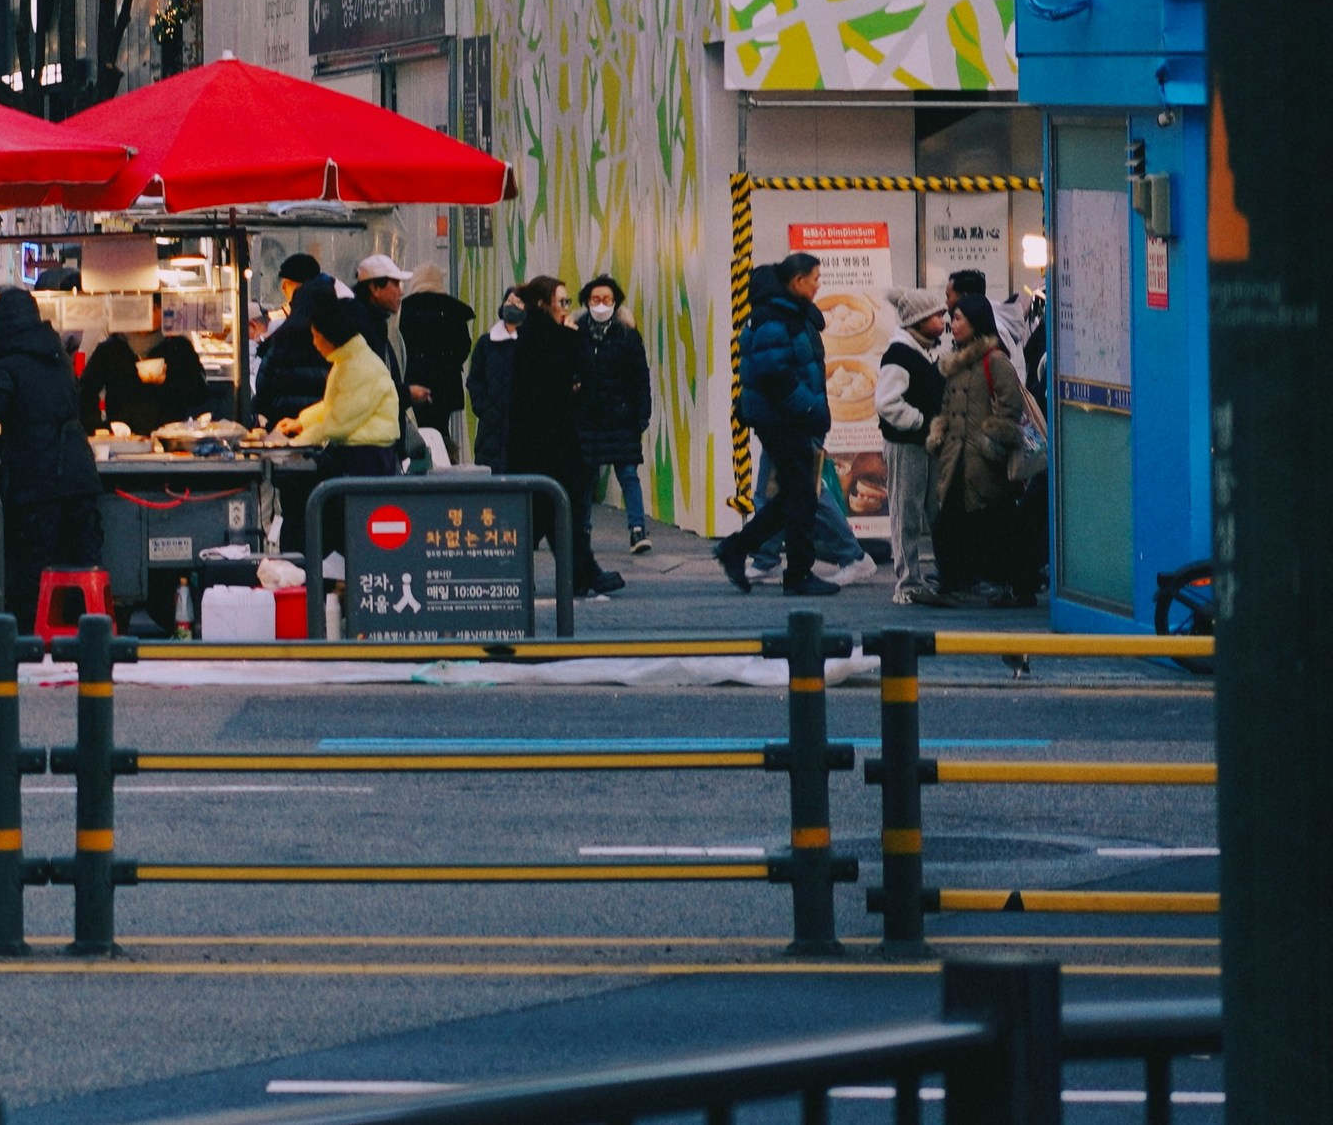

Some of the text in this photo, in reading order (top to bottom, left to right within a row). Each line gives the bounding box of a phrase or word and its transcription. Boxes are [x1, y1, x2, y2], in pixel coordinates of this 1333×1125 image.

[828, 227, 875, 237] DimDimSum
[427, 585, 449, 600] 매일
[360, 595, 389, 614] 서울
